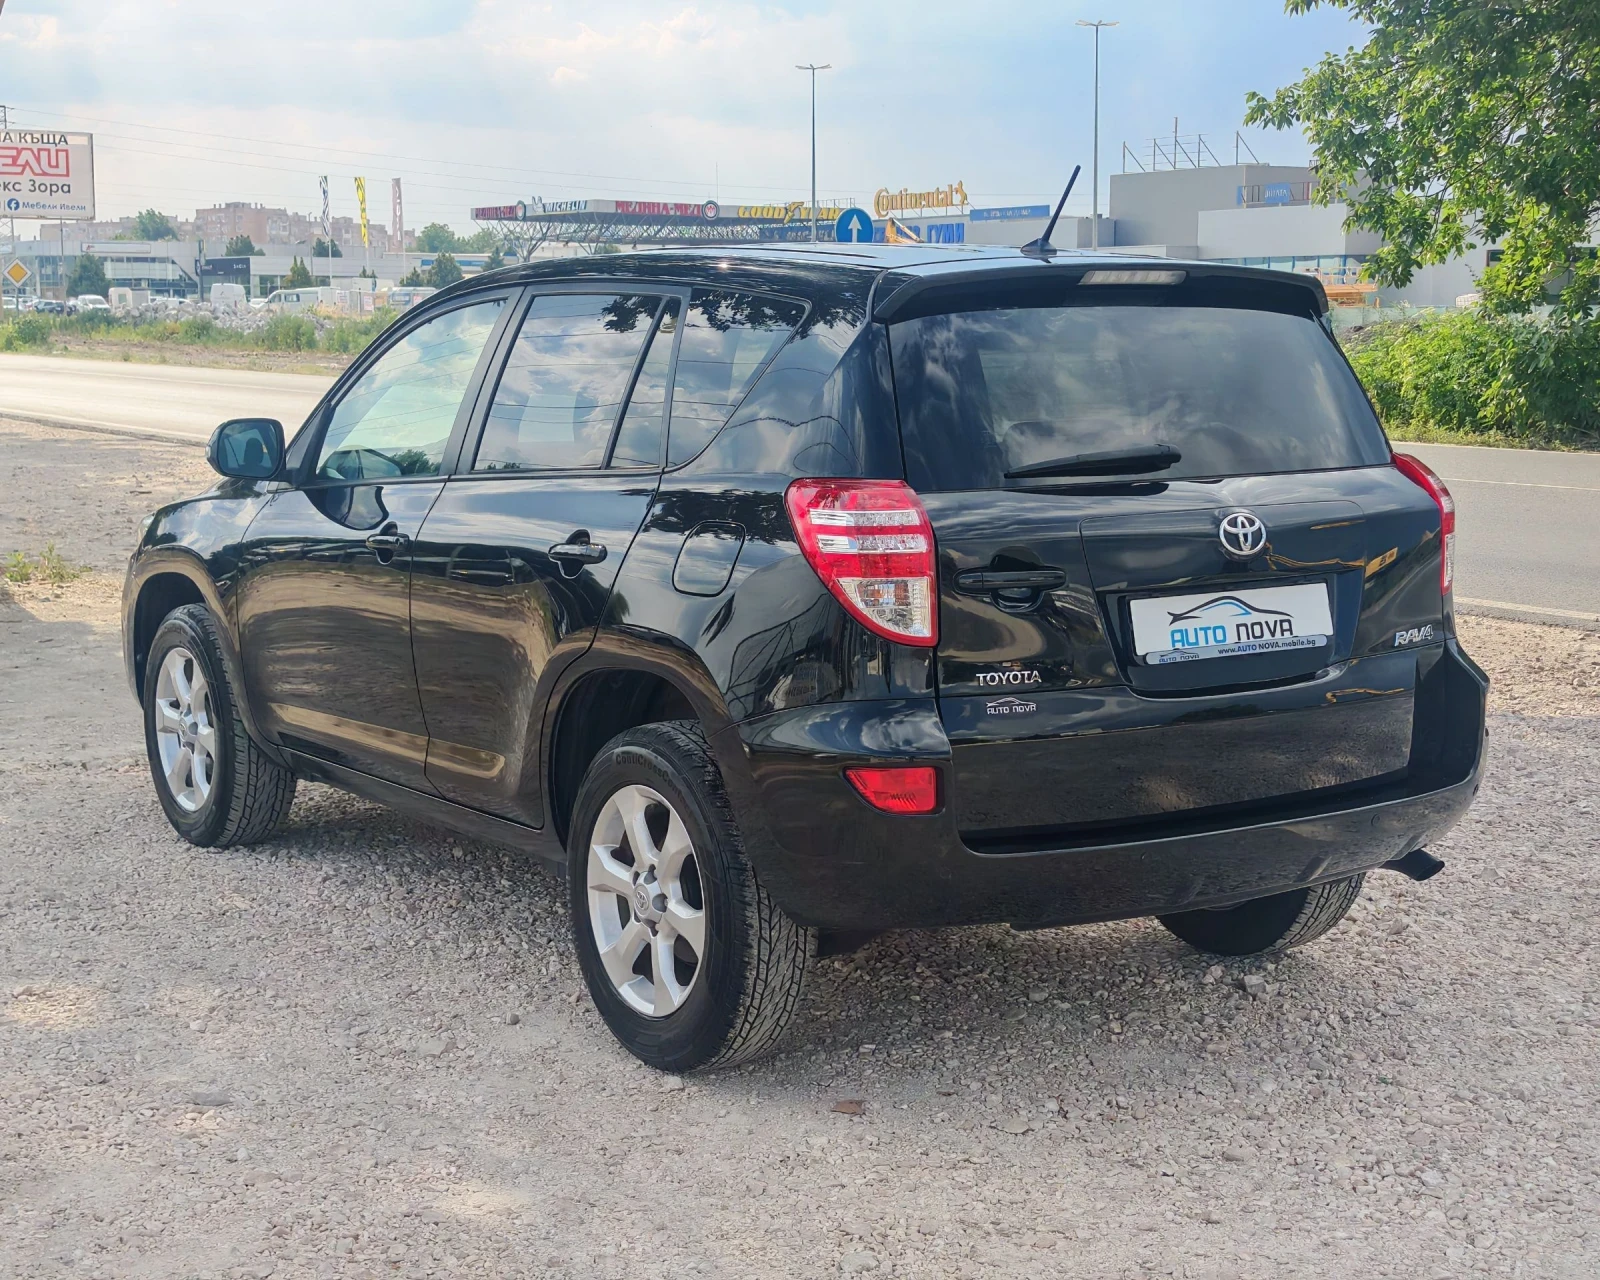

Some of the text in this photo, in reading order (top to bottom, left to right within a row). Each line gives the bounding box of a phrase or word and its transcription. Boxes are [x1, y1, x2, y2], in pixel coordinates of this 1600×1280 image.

[0, 132, 69, 147] А КЪЩА
[0, 178, 71, 197] кс Зора
[22, 202, 86, 211] Мебели Ивели
[545, 200, 588, 213] MICHELIN
[874, 184, 954, 218] Continental
[926, 222, 965, 244] ГУМИ
[1170, 618, 1294, 648] AUTO NOVA
[1394, 624, 1434, 647] RAV4
[975, 670, 1042, 686] TOYOTA
[986, 704, 1037, 715] AUTO NOVA
